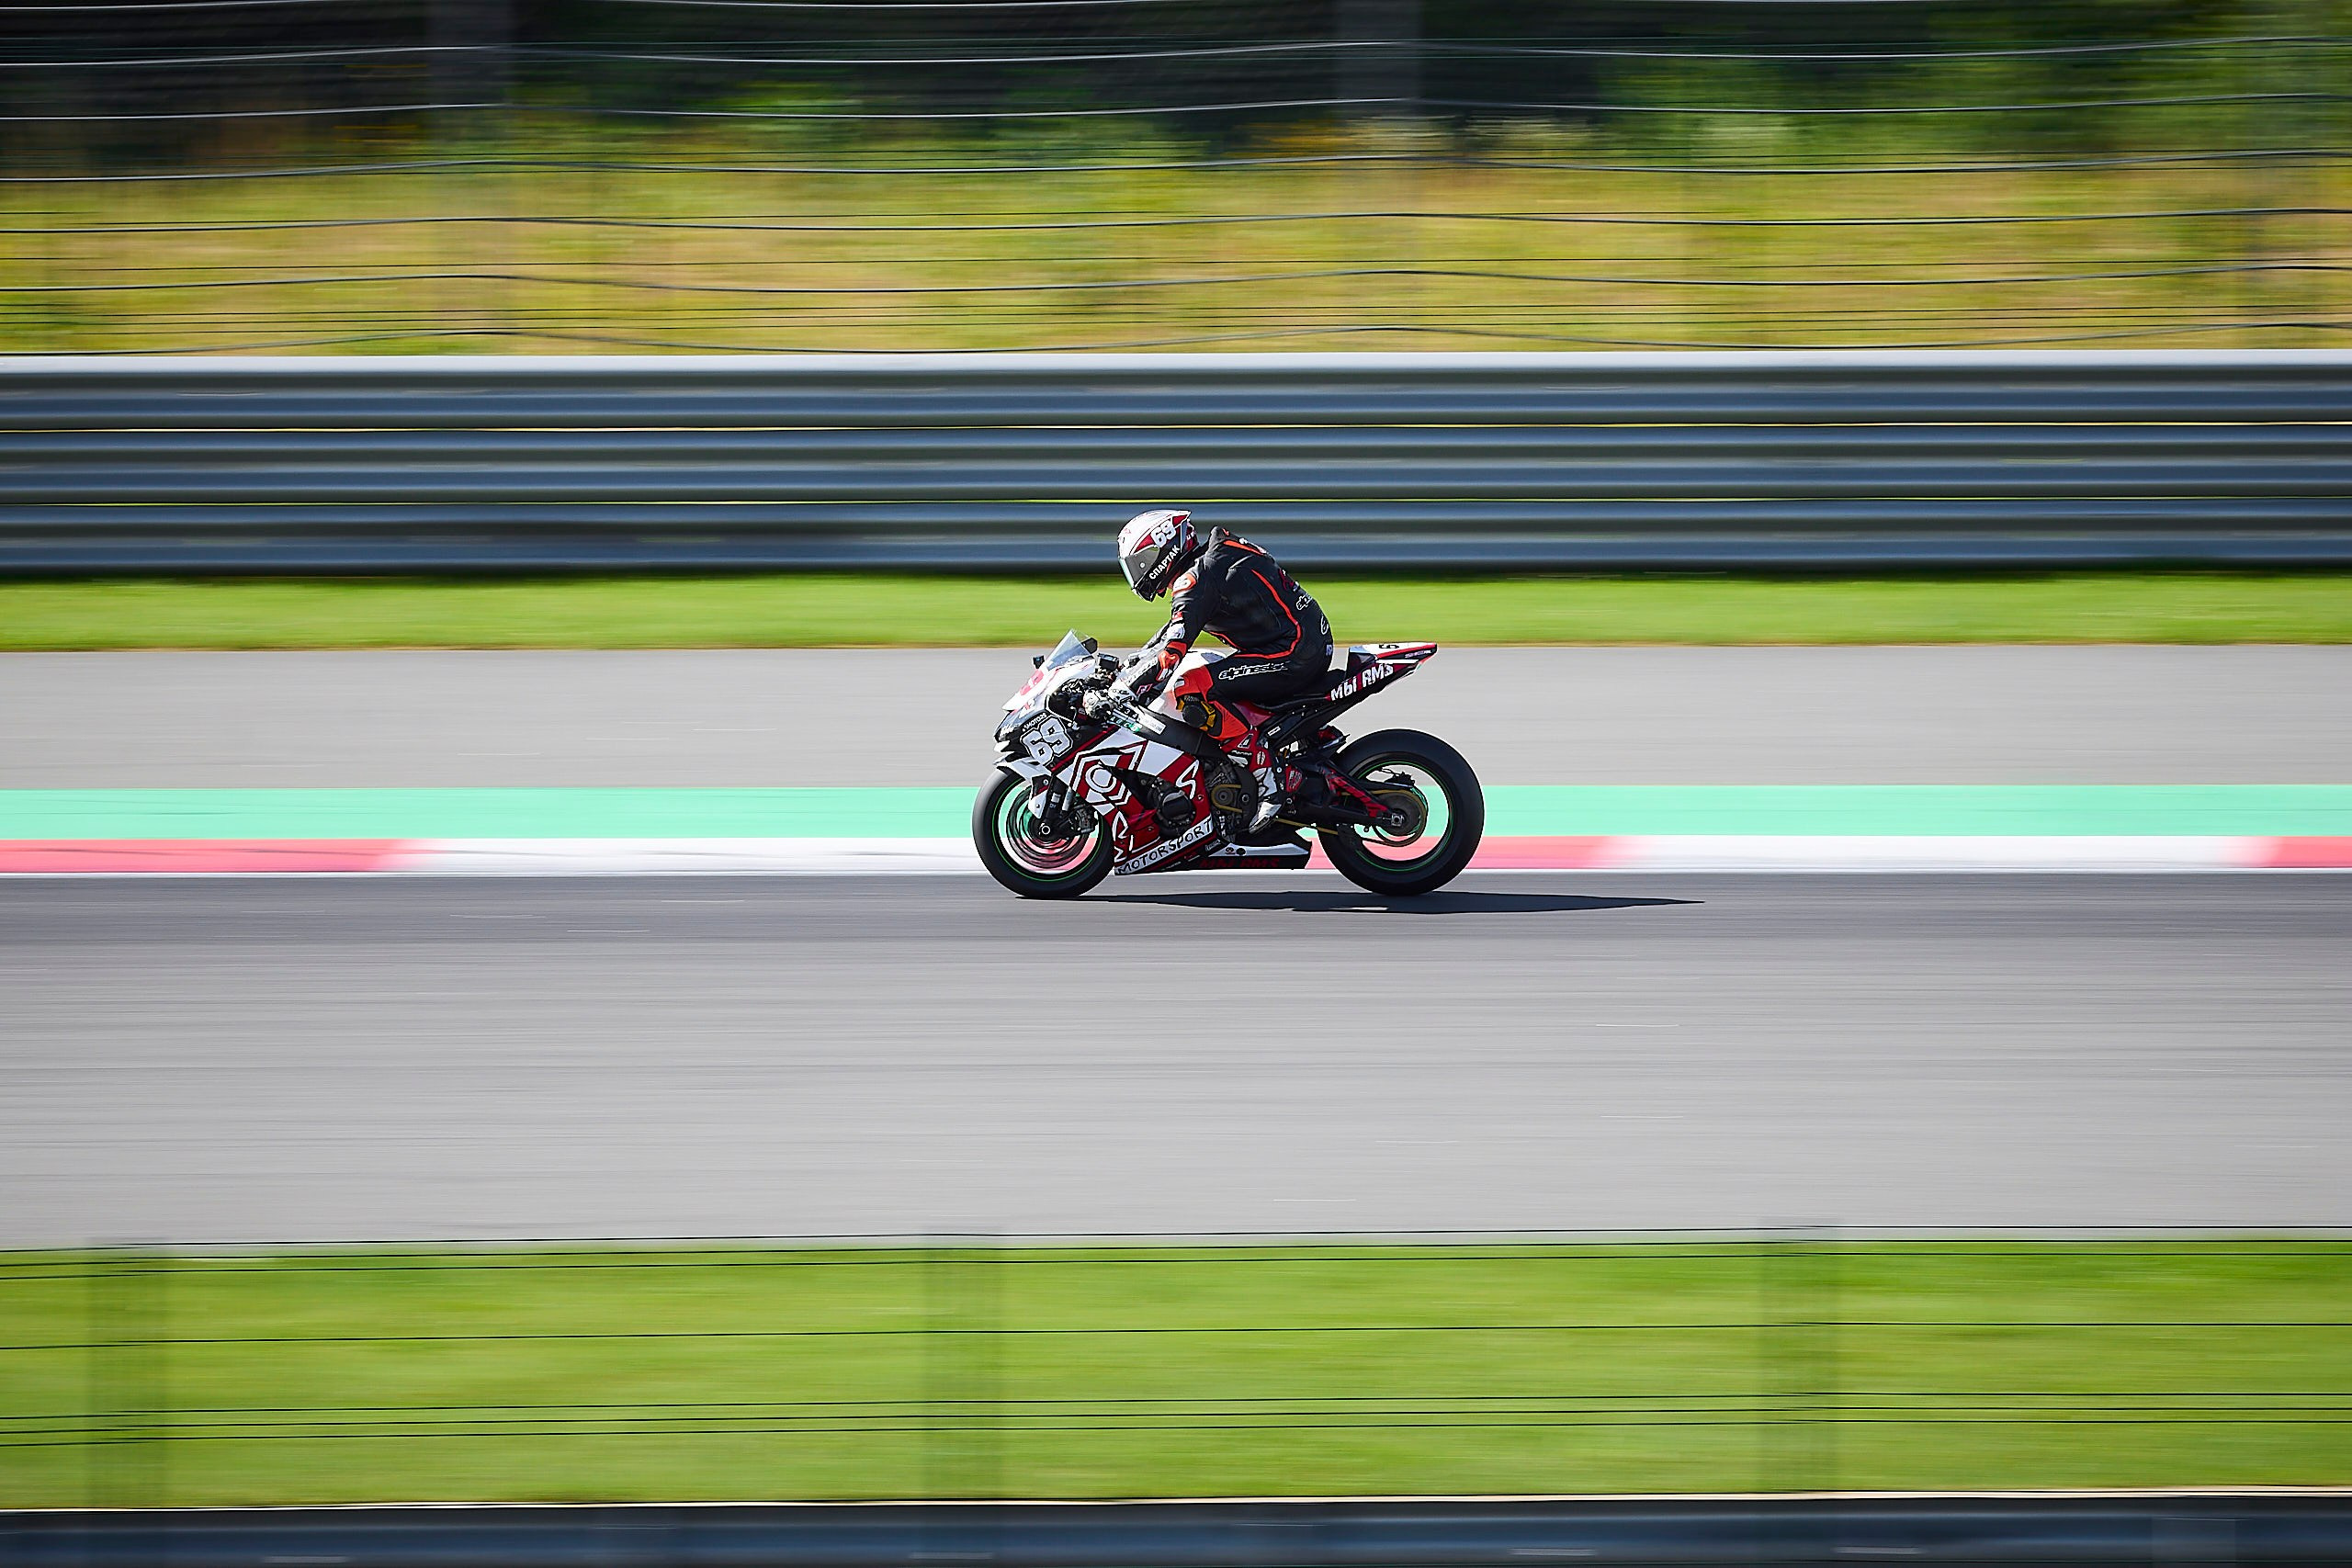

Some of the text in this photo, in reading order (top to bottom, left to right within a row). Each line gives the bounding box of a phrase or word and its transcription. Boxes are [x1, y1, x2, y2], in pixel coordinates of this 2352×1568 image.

[1151, 517, 1177, 548] 69
[1148, 545, 1181, 580] СПАРТАК
[1020, 716, 1073, 767] 69
[1117, 818, 1212, 874] MOTORSPORT
